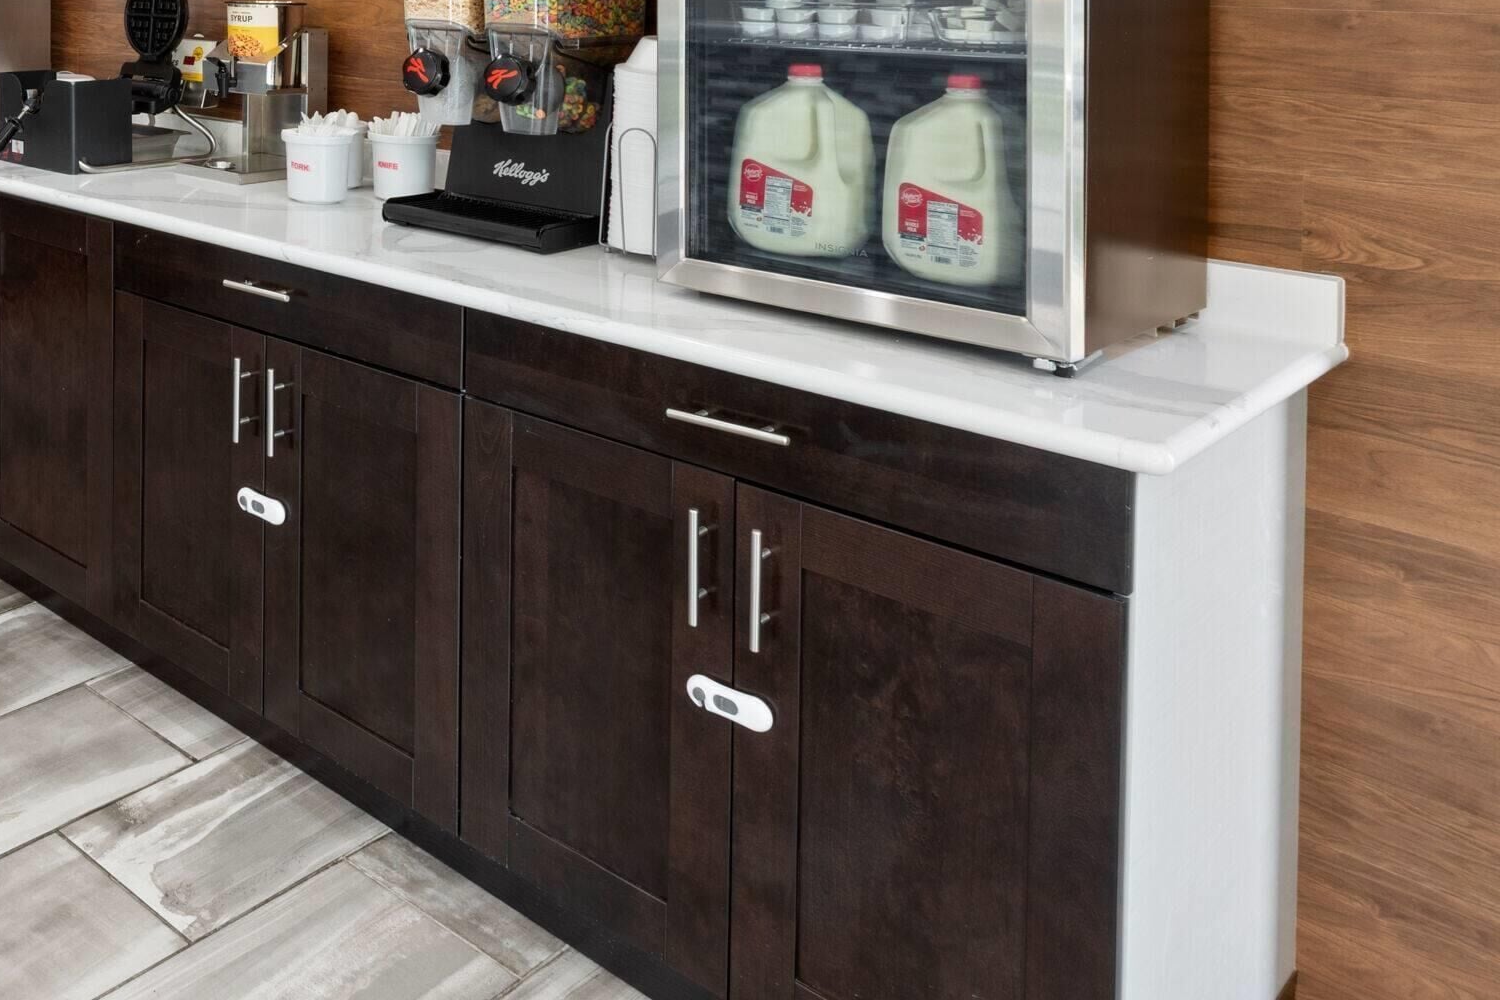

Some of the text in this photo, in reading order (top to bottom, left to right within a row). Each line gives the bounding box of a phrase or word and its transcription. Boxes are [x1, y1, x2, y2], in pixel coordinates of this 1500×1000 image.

[230, 14, 253, 23] SYRUP
[291, 161, 309, 172] FORK
[378, 160, 398, 171] KNIFE
[493, 159, 550, 186] Kellogg's
